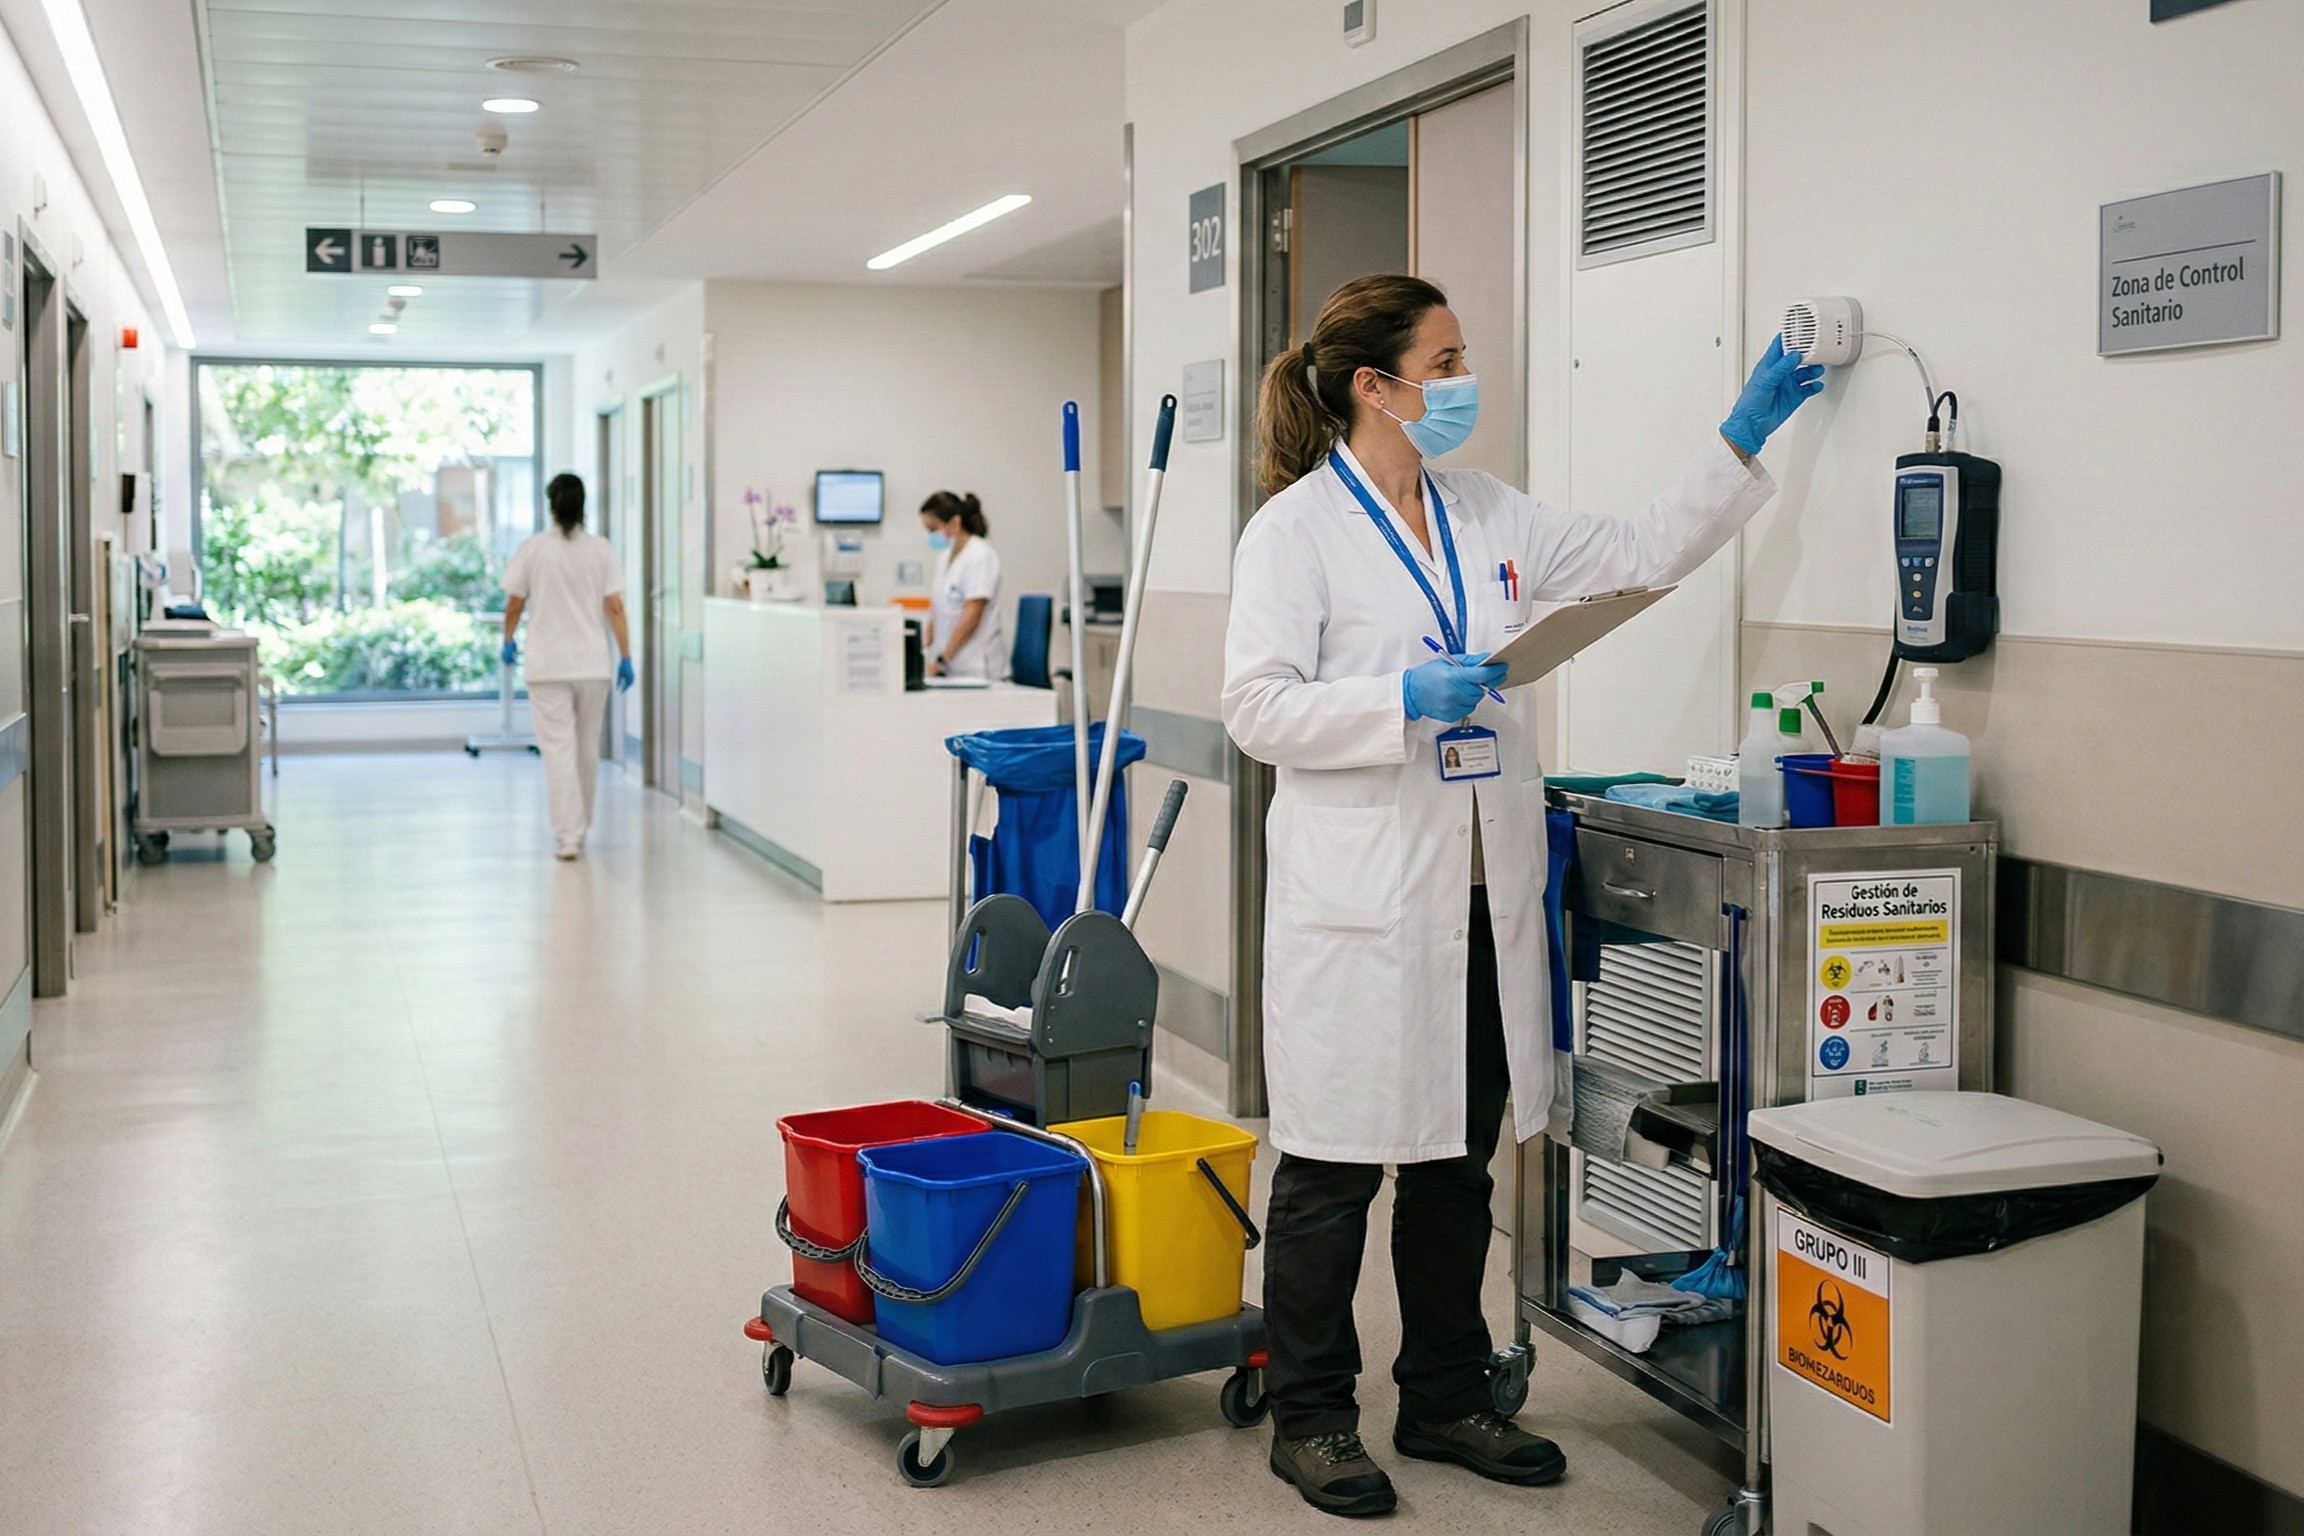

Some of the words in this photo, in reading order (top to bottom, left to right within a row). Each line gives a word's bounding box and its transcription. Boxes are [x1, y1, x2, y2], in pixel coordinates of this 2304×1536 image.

[1192, 215, 1221, 262] 302
[2112, 276, 2150, 297] Zona
[2154, 267, 2175, 292] de
[2180, 256, 2244, 288] Control
[2112, 299, 2183, 328] Sanitario
[1821, 903, 1880, 919] Residuos
[1883, 899, 1947, 916] Sanitarios
[1851, 883, 1899, 900] Gestión
[1902, 883, 1918, 898] de
[1795, 1228, 1848, 1271] GRUPO
[1853, 1253, 1866, 1280] III
